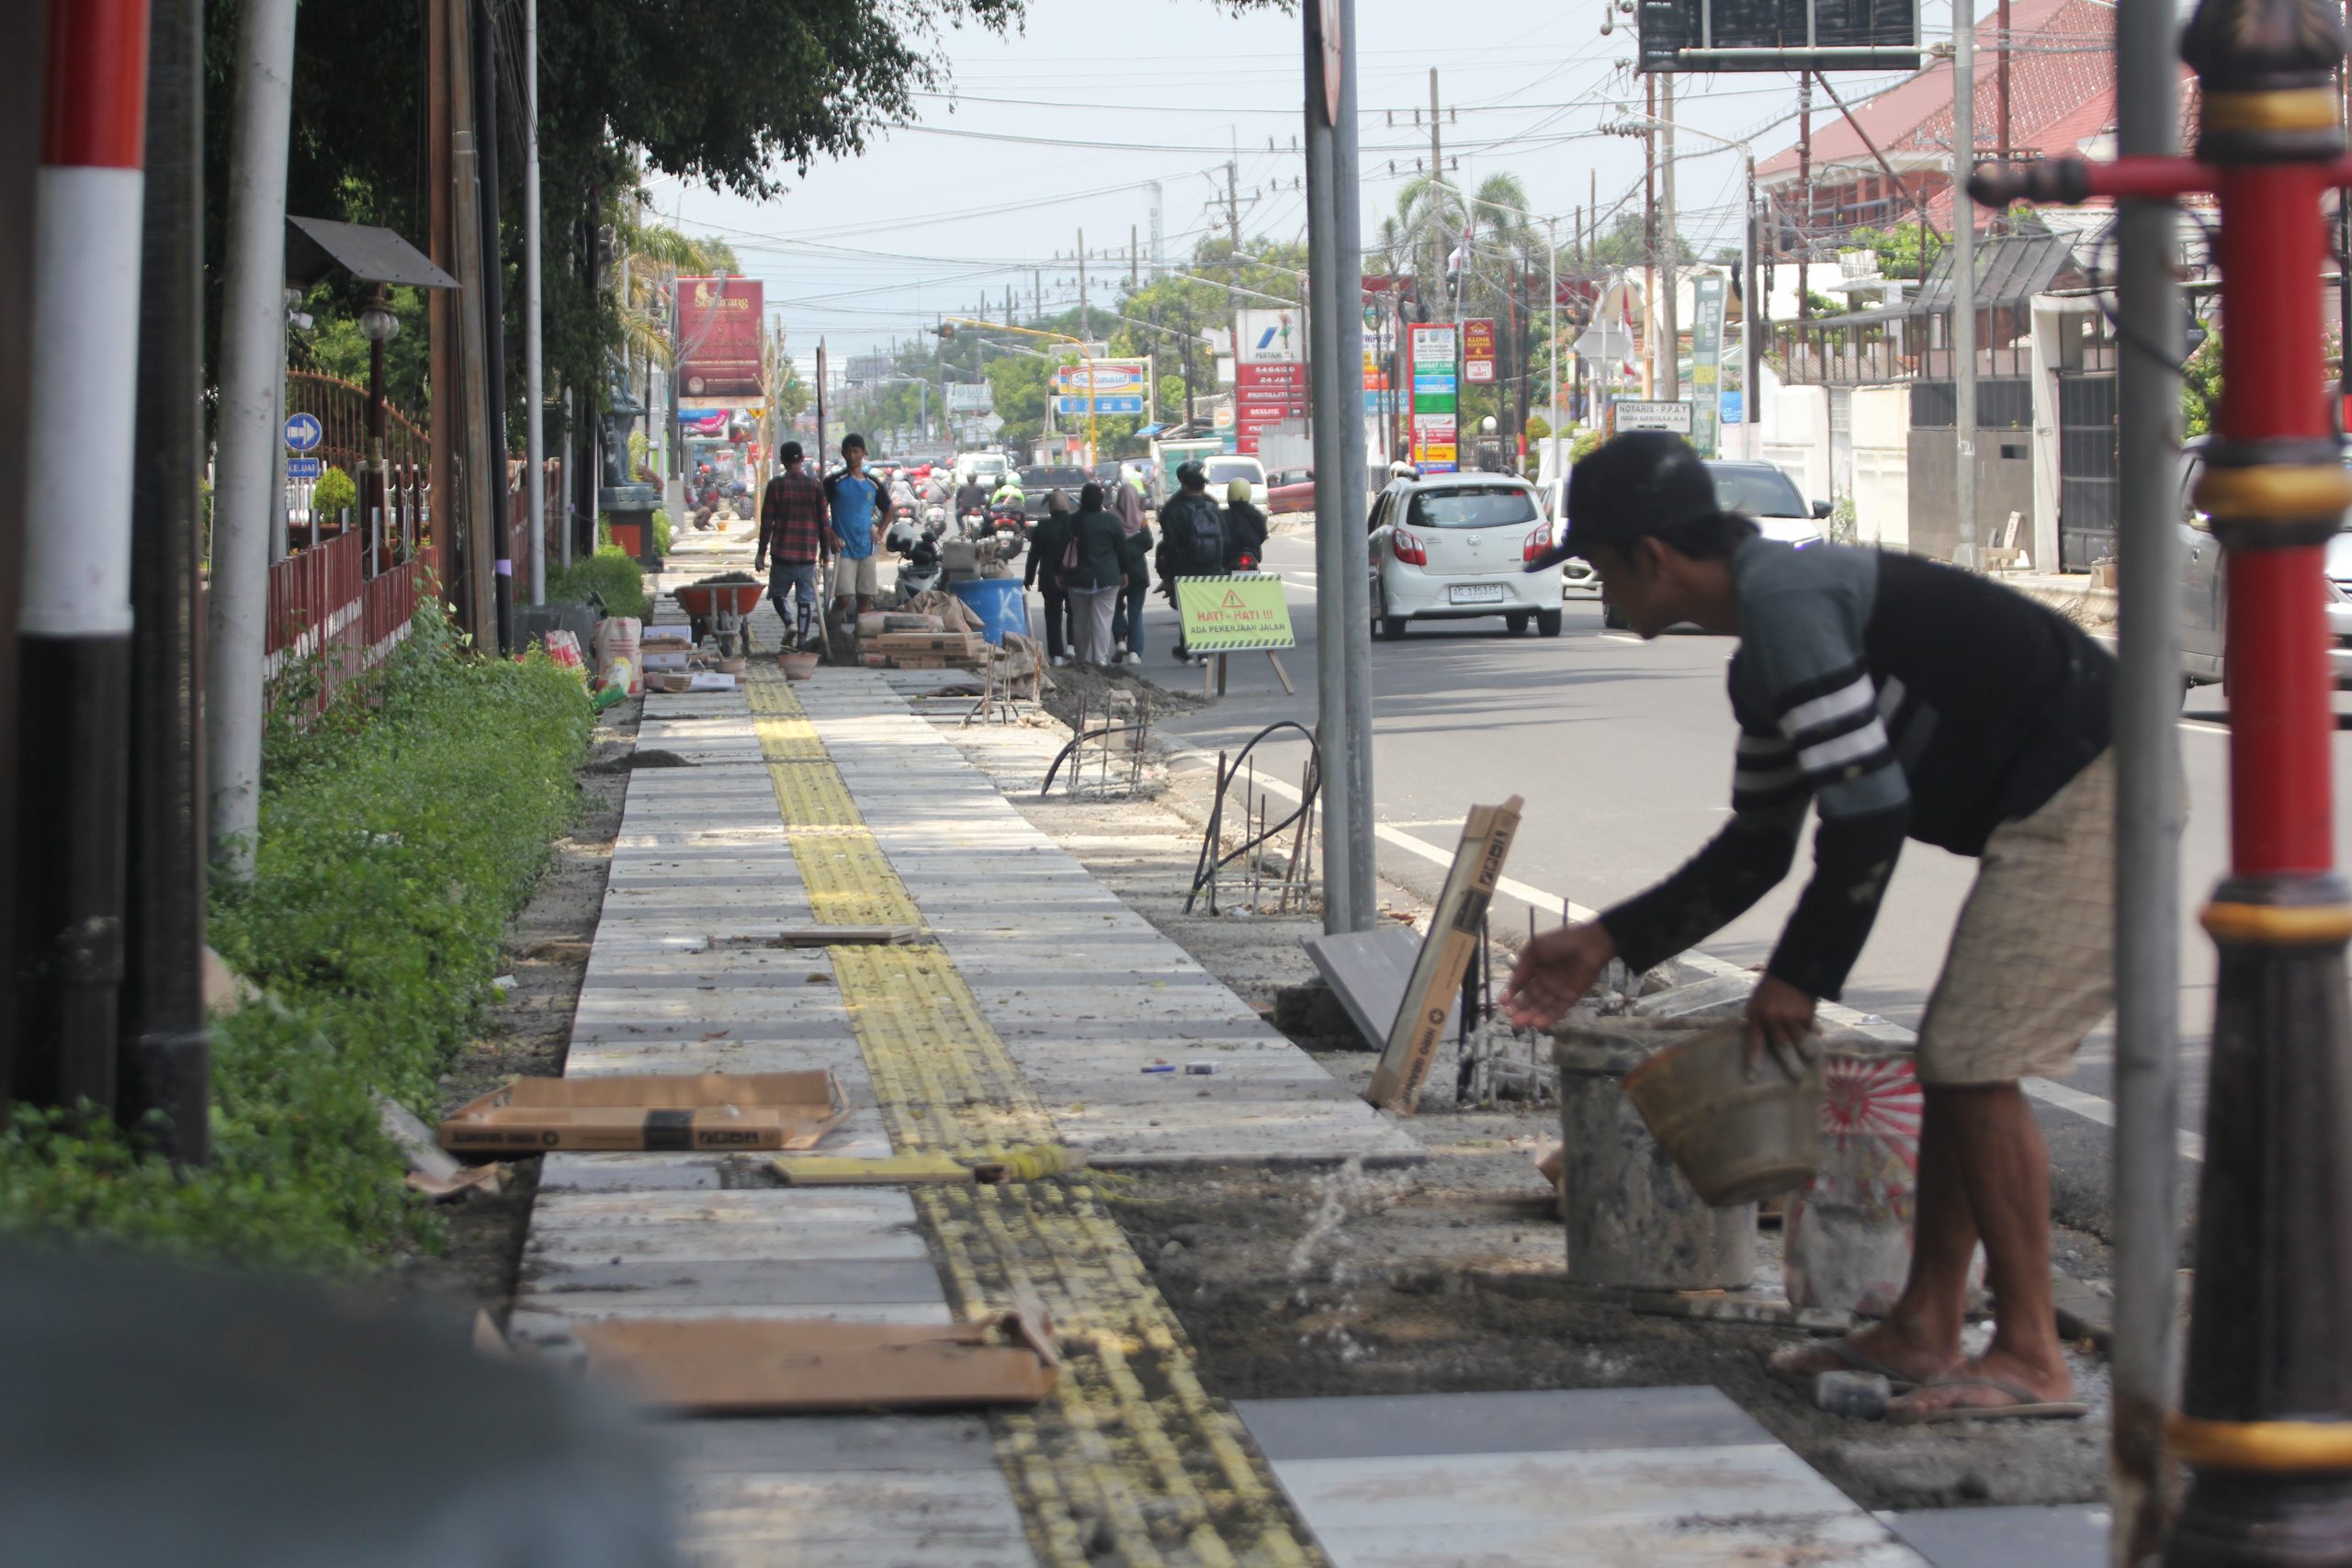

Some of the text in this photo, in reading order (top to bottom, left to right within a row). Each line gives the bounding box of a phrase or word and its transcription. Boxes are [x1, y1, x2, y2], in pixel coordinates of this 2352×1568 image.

[1074, 373, 1127, 385] Inomaret
[1453, 588, 1464, 596] AG
[1197, 611, 1224, 621] HATI
[1234, 610, 1260, 620] HATI
[1263, 610, 1273, 619] !!!
[1209, 625, 1257, 633] PEKERJAAN
[1260, 623, 1285, 631] JALAN
